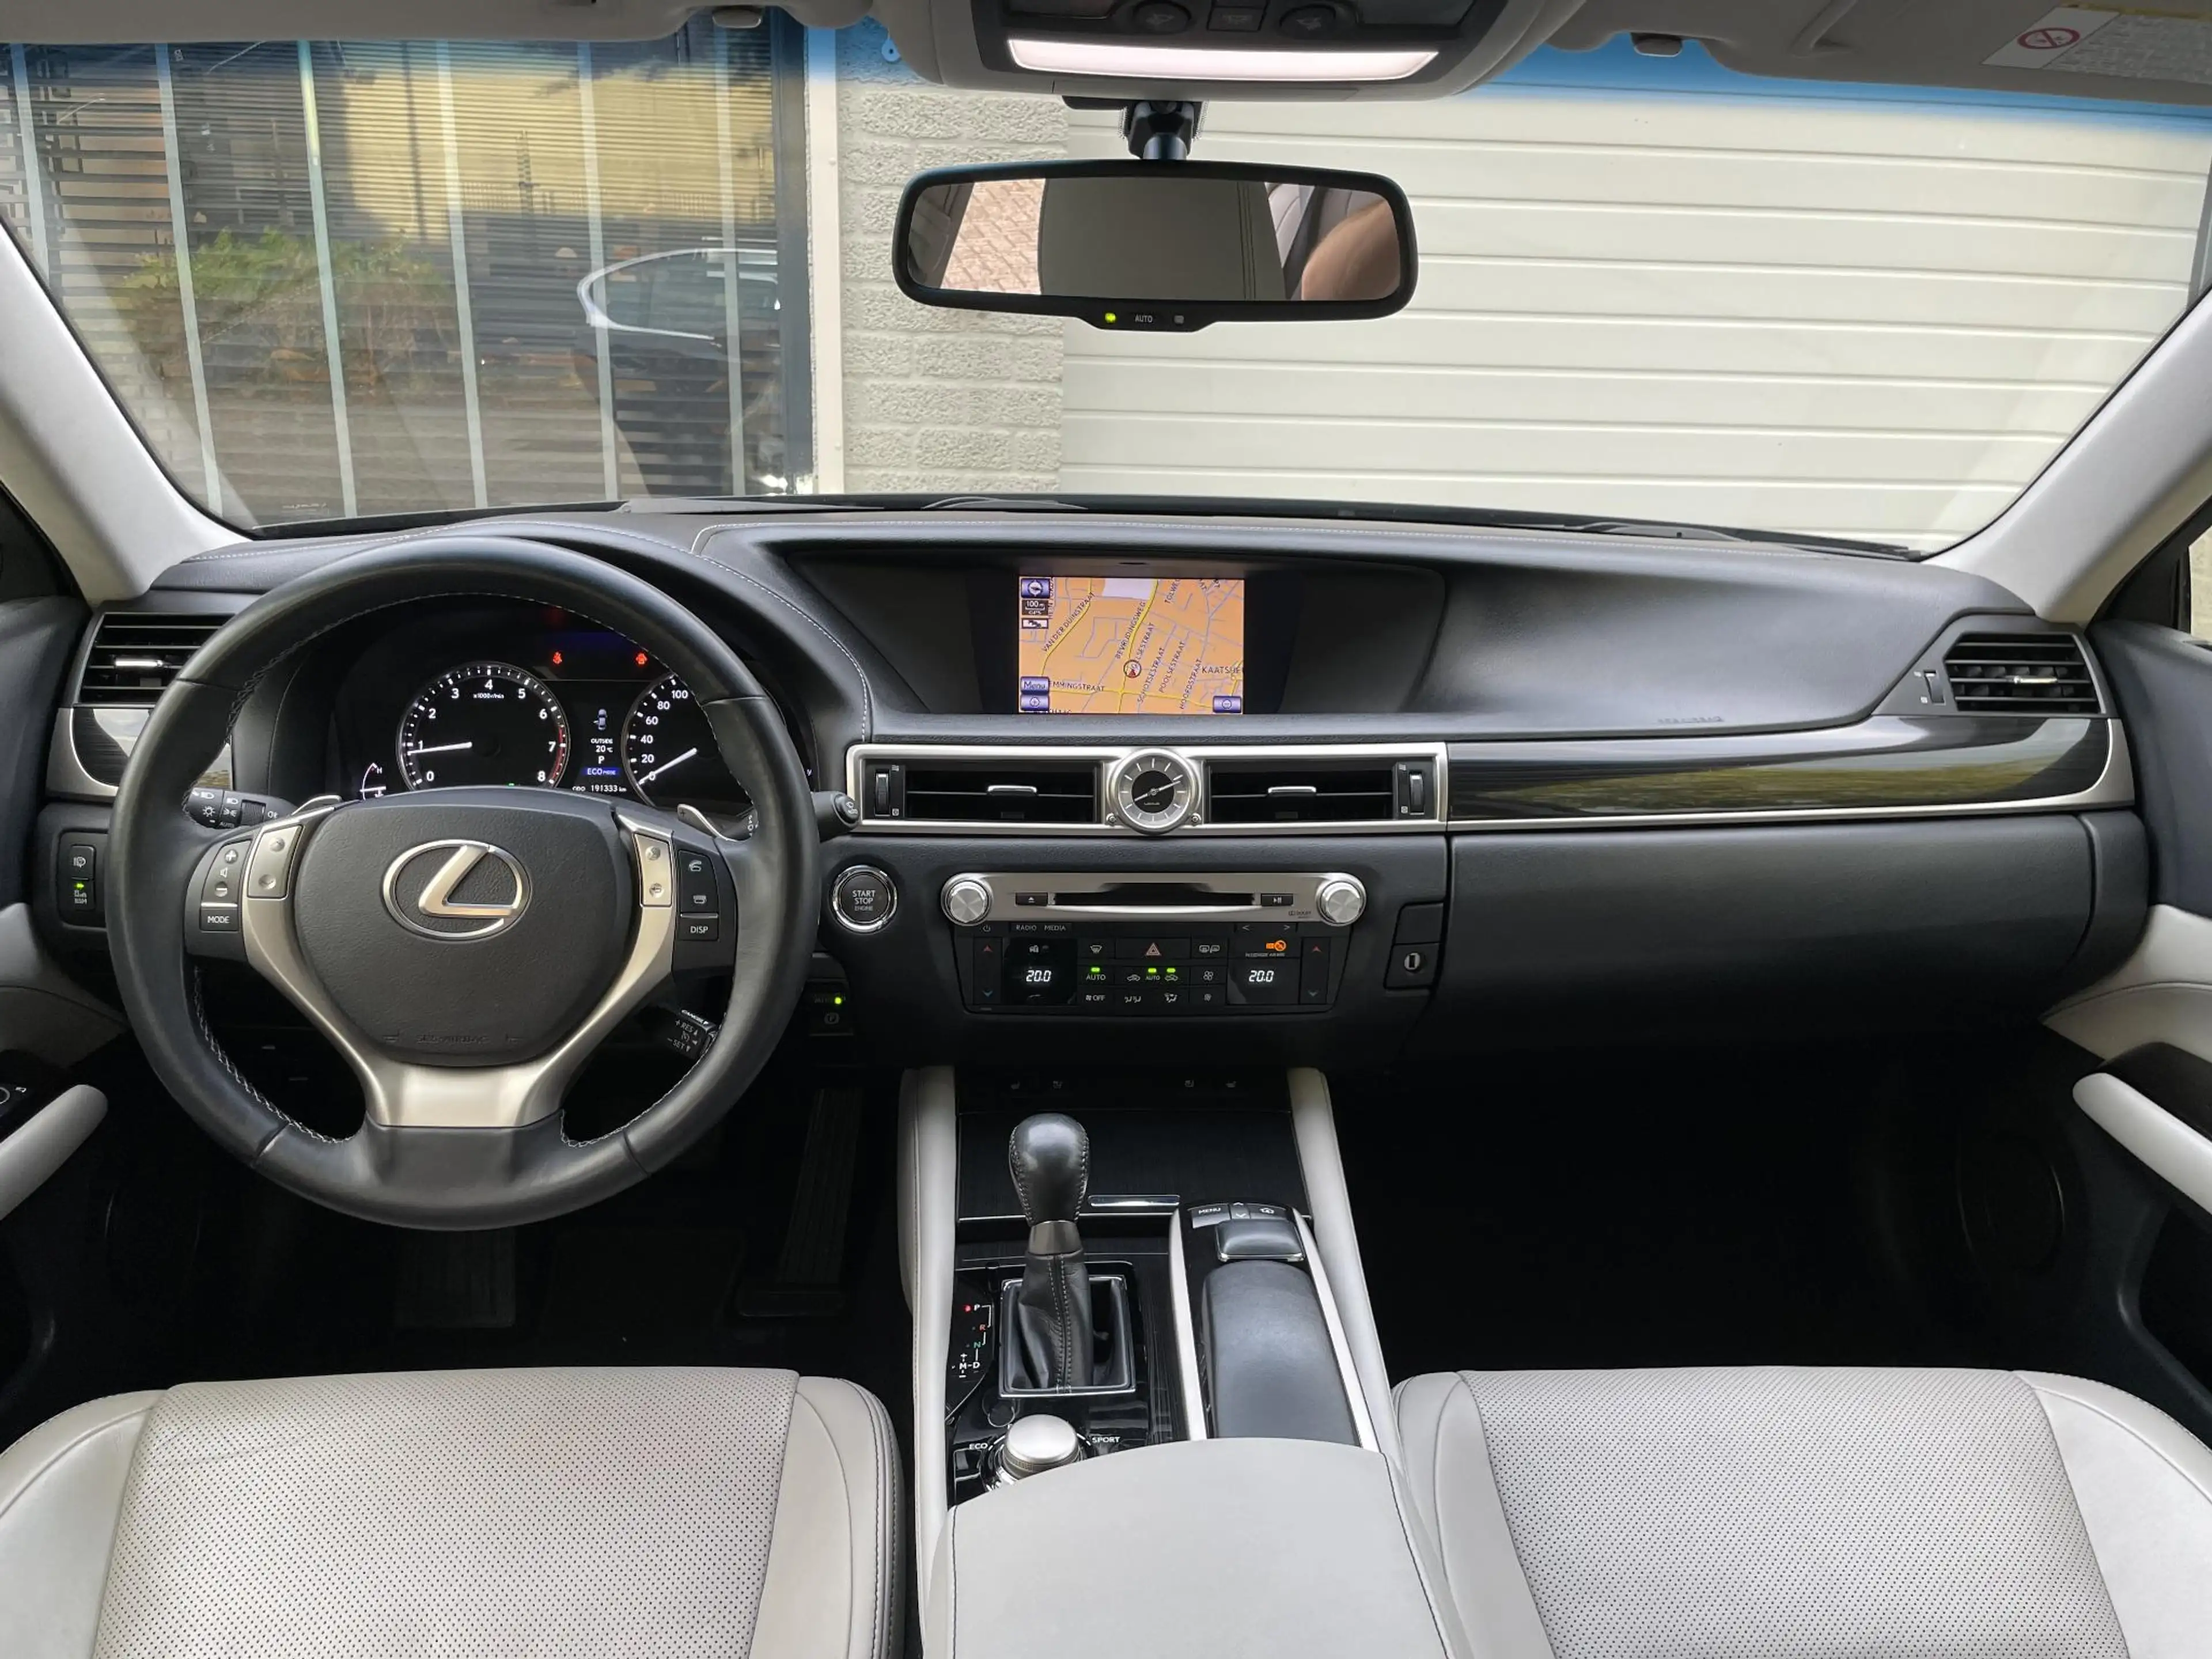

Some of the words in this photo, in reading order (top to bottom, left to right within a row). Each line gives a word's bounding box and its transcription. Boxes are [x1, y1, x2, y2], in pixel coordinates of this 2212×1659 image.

[485, 679, 494, 690] 4
[1024, 681, 1046, 690] Menu
[451, 688, 459, 699] 3
[518, 688, 526, 699] 5
[672, 690, 688, 699] 100
[657, 701, 670, 710] 80
[429, 709, 436, 719] 2
[539, 709, 547, 719] 6
[646, 716, 658, 725] 60
[641, 734, 653, 744] 40
[418, 740, 423, 751] 1
[548, 742, 556, 752] 7
[599, 756, 605, 764] P
[641, 754, 654, 763] 20
[426, 771, 434, 781] 0
[537, 771, 546, 781] 8
[690, 926, 709, 934] DISP
[1026, 969, 1052, 982] 20.0
[1248, 970, 1275, 983] 20.0
[959, 1362, 967, 1370] M
[972, 1361, 980, 1369] D
